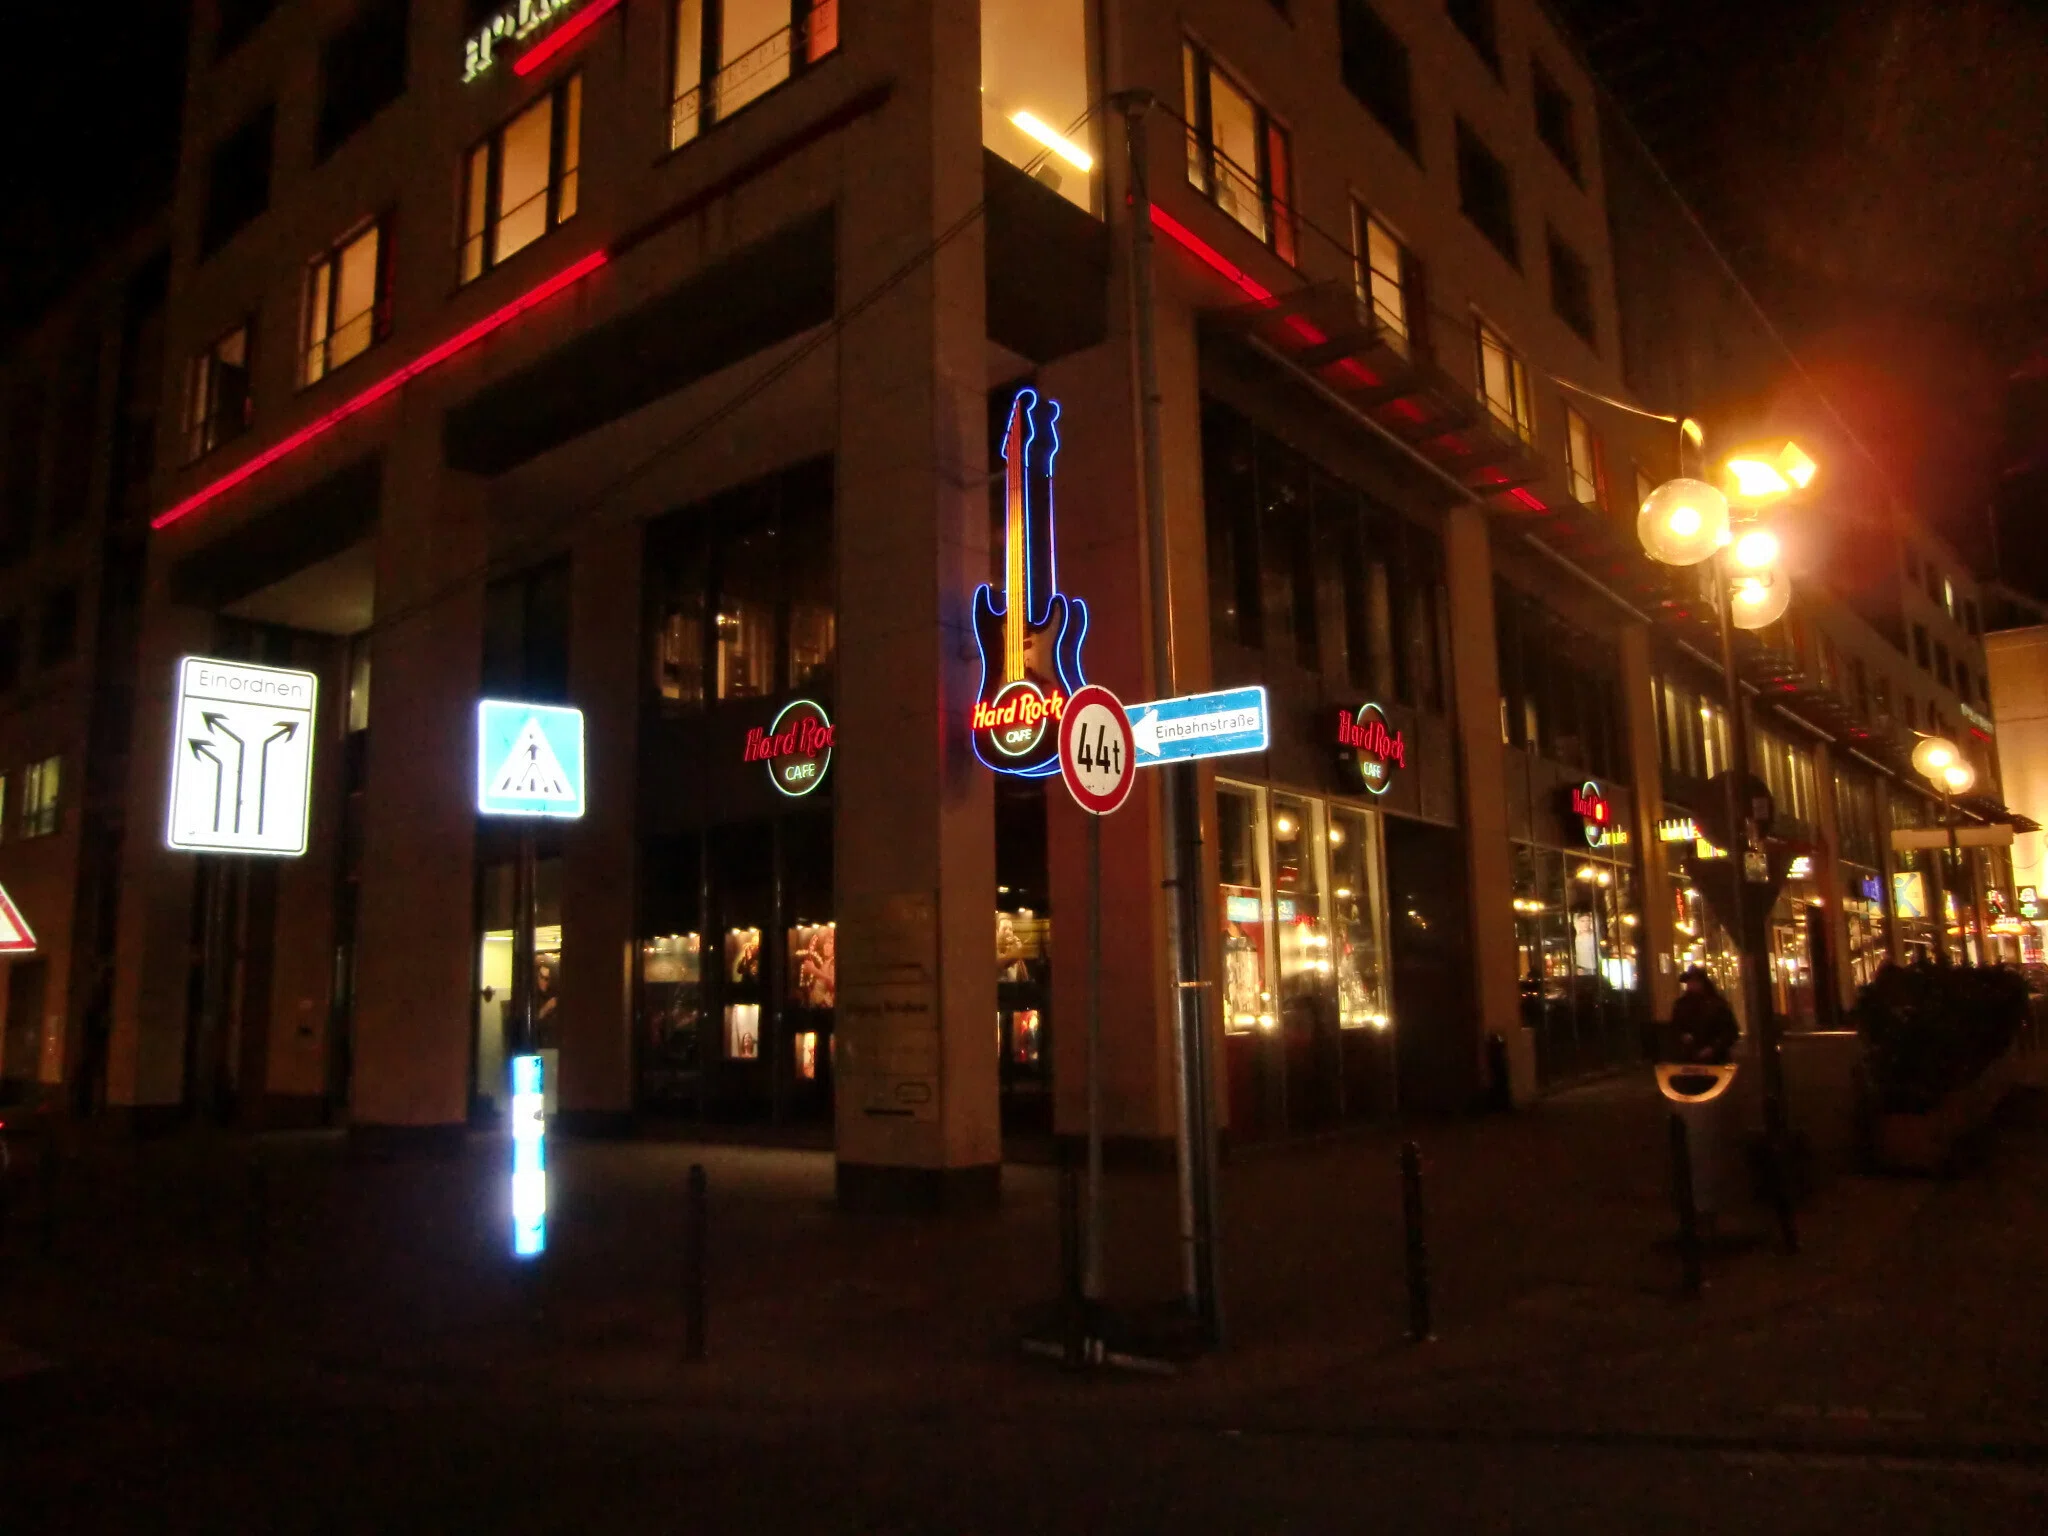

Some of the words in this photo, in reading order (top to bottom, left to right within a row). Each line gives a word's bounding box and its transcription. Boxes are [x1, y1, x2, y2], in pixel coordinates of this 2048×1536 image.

[199, 669, 302, 697] Einordnen
[973, 698, 1017, 729] Hard
[1019, 689, 1064, 725] Rock
[743, 720, 799, 762] Hard
[799, 716, 836, 759] Roc
[1006, 728, 1033, 743] CAFE
[1155, 713, 1255, 740] Einbahnstraße
[1339, 710, 1374, 750] Hard
[1374, 721, 1406, 769] Rock
[1077, 722, 1121, 775] 44t
[785, 763, 816, 781] CAFE
[1363, 761, 1382, 779] CAFE
